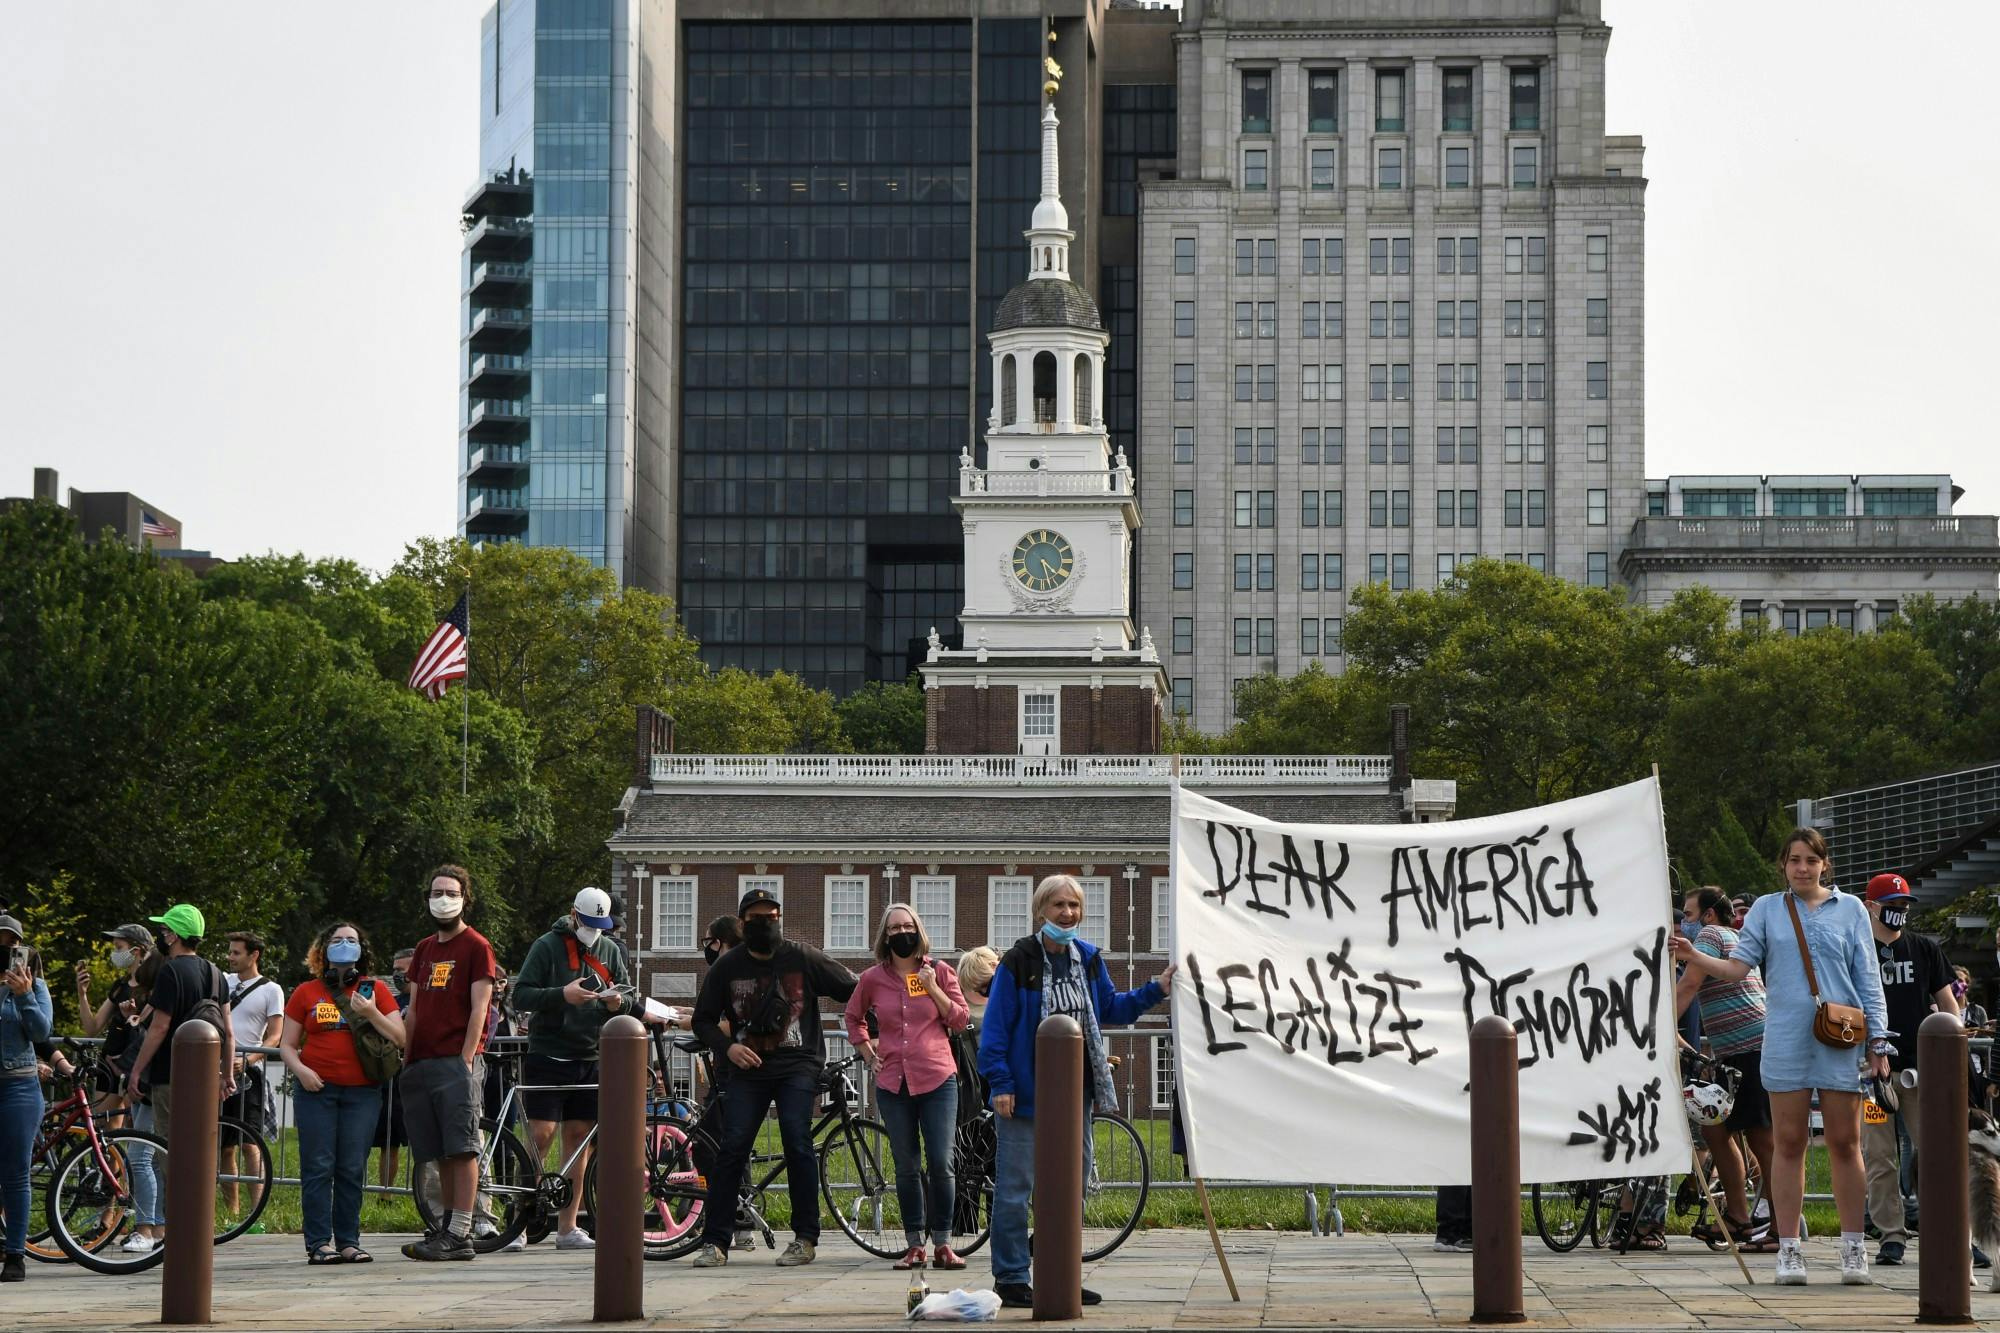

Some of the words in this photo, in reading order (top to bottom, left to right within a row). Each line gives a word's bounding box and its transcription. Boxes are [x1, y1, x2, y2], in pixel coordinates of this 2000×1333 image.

[1203, 820, 1356, 920] DEAR
[1380, 825, 1598, 948] AMERICA
[1881, 961, 1915, 985] OTE
[910, 978, 924, 987] OU
[910, 985, 924, 993] NO
[1186, 937, 1439, 1066] LEGALIZE
[317, 1012, 339, 1020] NOW
[1865, 1111, 1886, 1120] NOW
